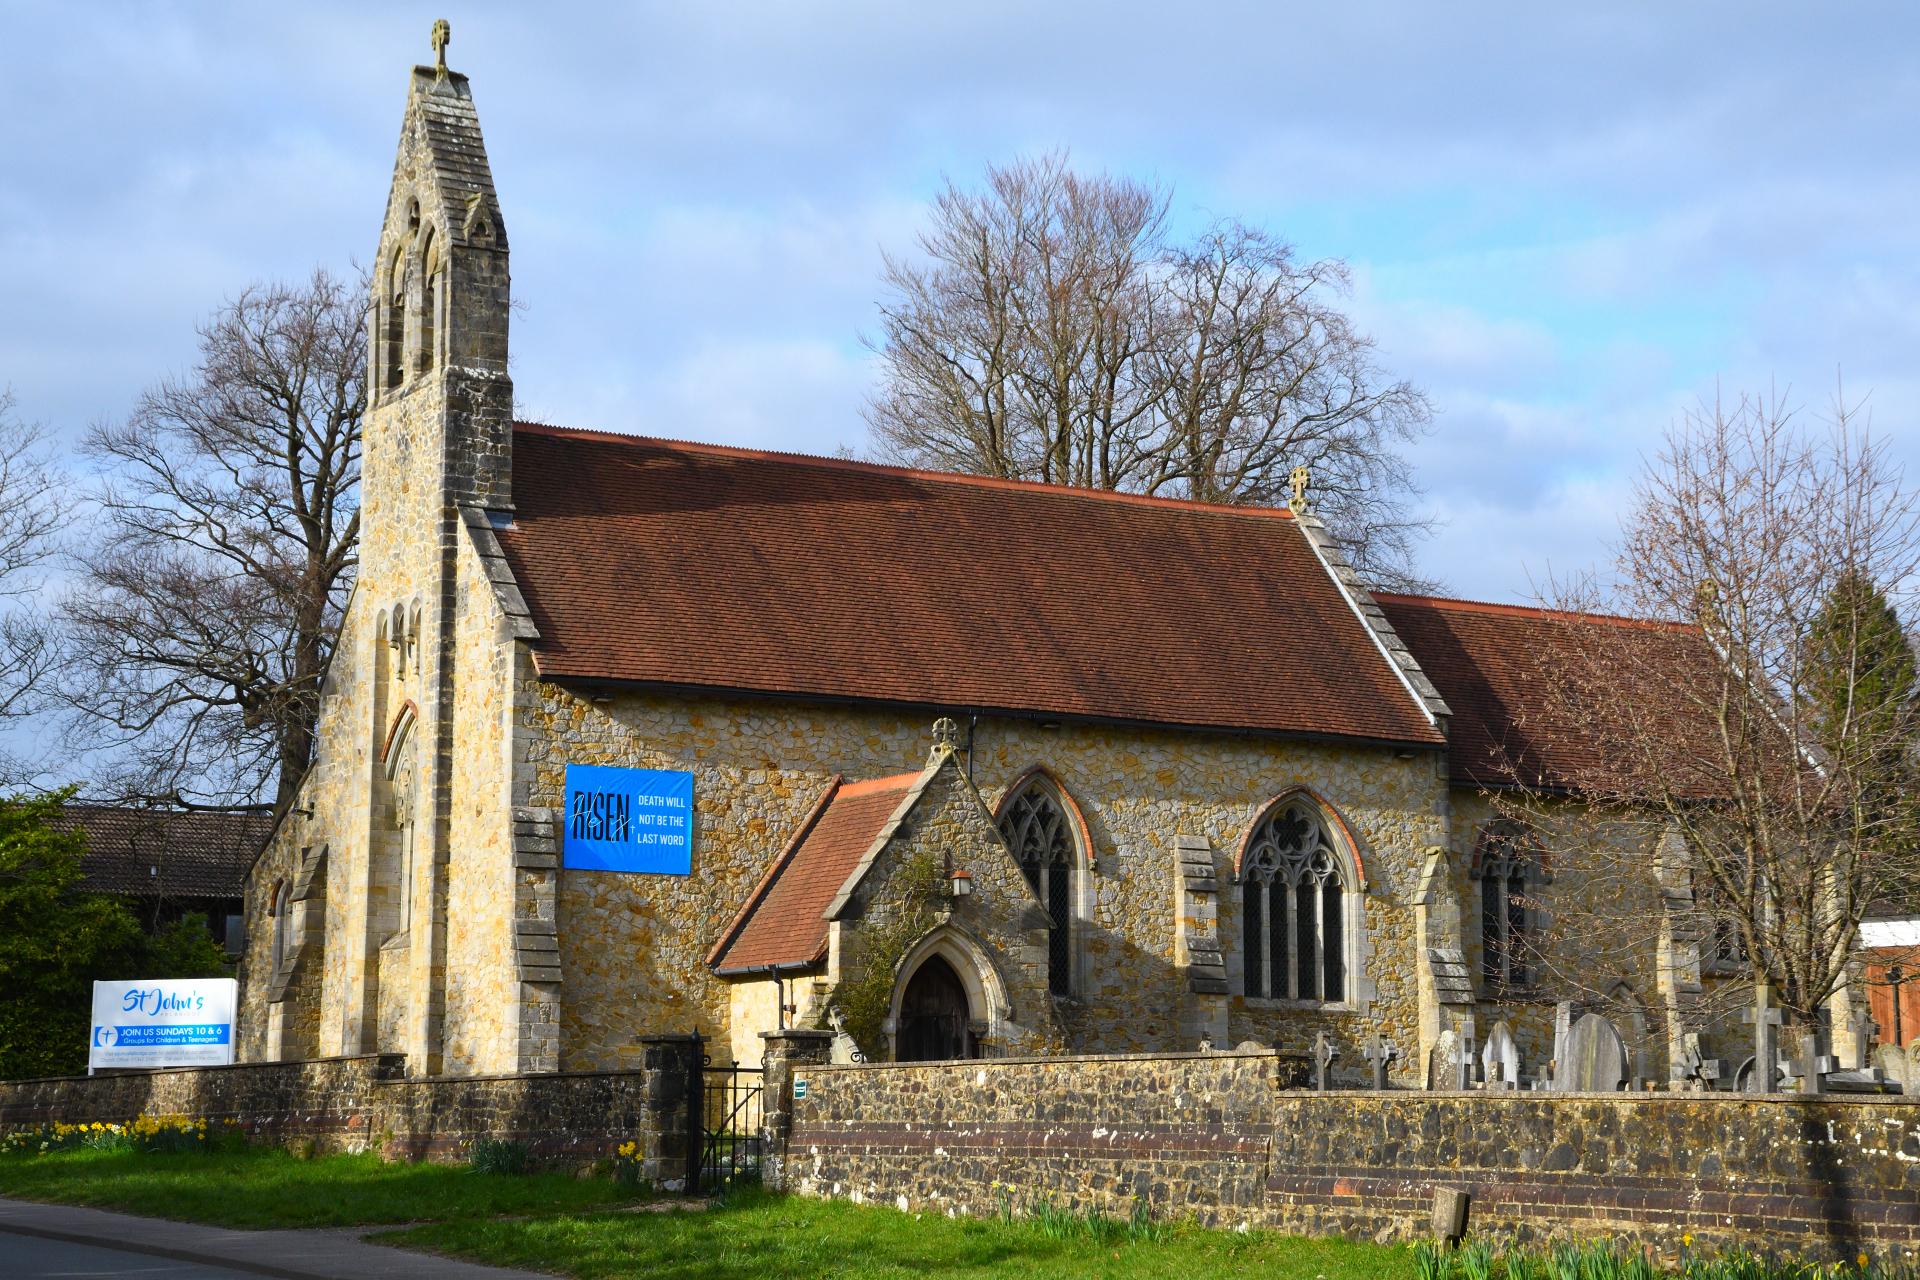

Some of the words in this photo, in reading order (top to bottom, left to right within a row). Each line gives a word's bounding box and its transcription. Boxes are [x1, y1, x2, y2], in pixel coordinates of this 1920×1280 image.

[638, 795, 664, 807] DEATH
[666, 797, 685, 808] WILL
[573, 791, 630, 843] RISEN
[639, 814, 656, 825] NOT
[657, 815, 668, 826] BE
[669, 816, 684, 827] THE
[637, 833, 659, 844] LAST
[660, 835, 684, 846] WORD
[122, 989, 149, 1012] St
[148, 988, 204, 1016] John's
[121, 1028, 142, 1037] JOIN
[143, 1028, 154, 1036] US
[156, 1027, 194, 1036] SUNDAYS
[196, 1027, 206, 1035] 10
[208, 1027, 214, 1035] &
[216, 1027, 222, 1035] 6
[123, 1037, 145, 1045] Groups
[156, 1036, 181, 1044] Children
[188, 1036, 218, 1044] Teenagers
